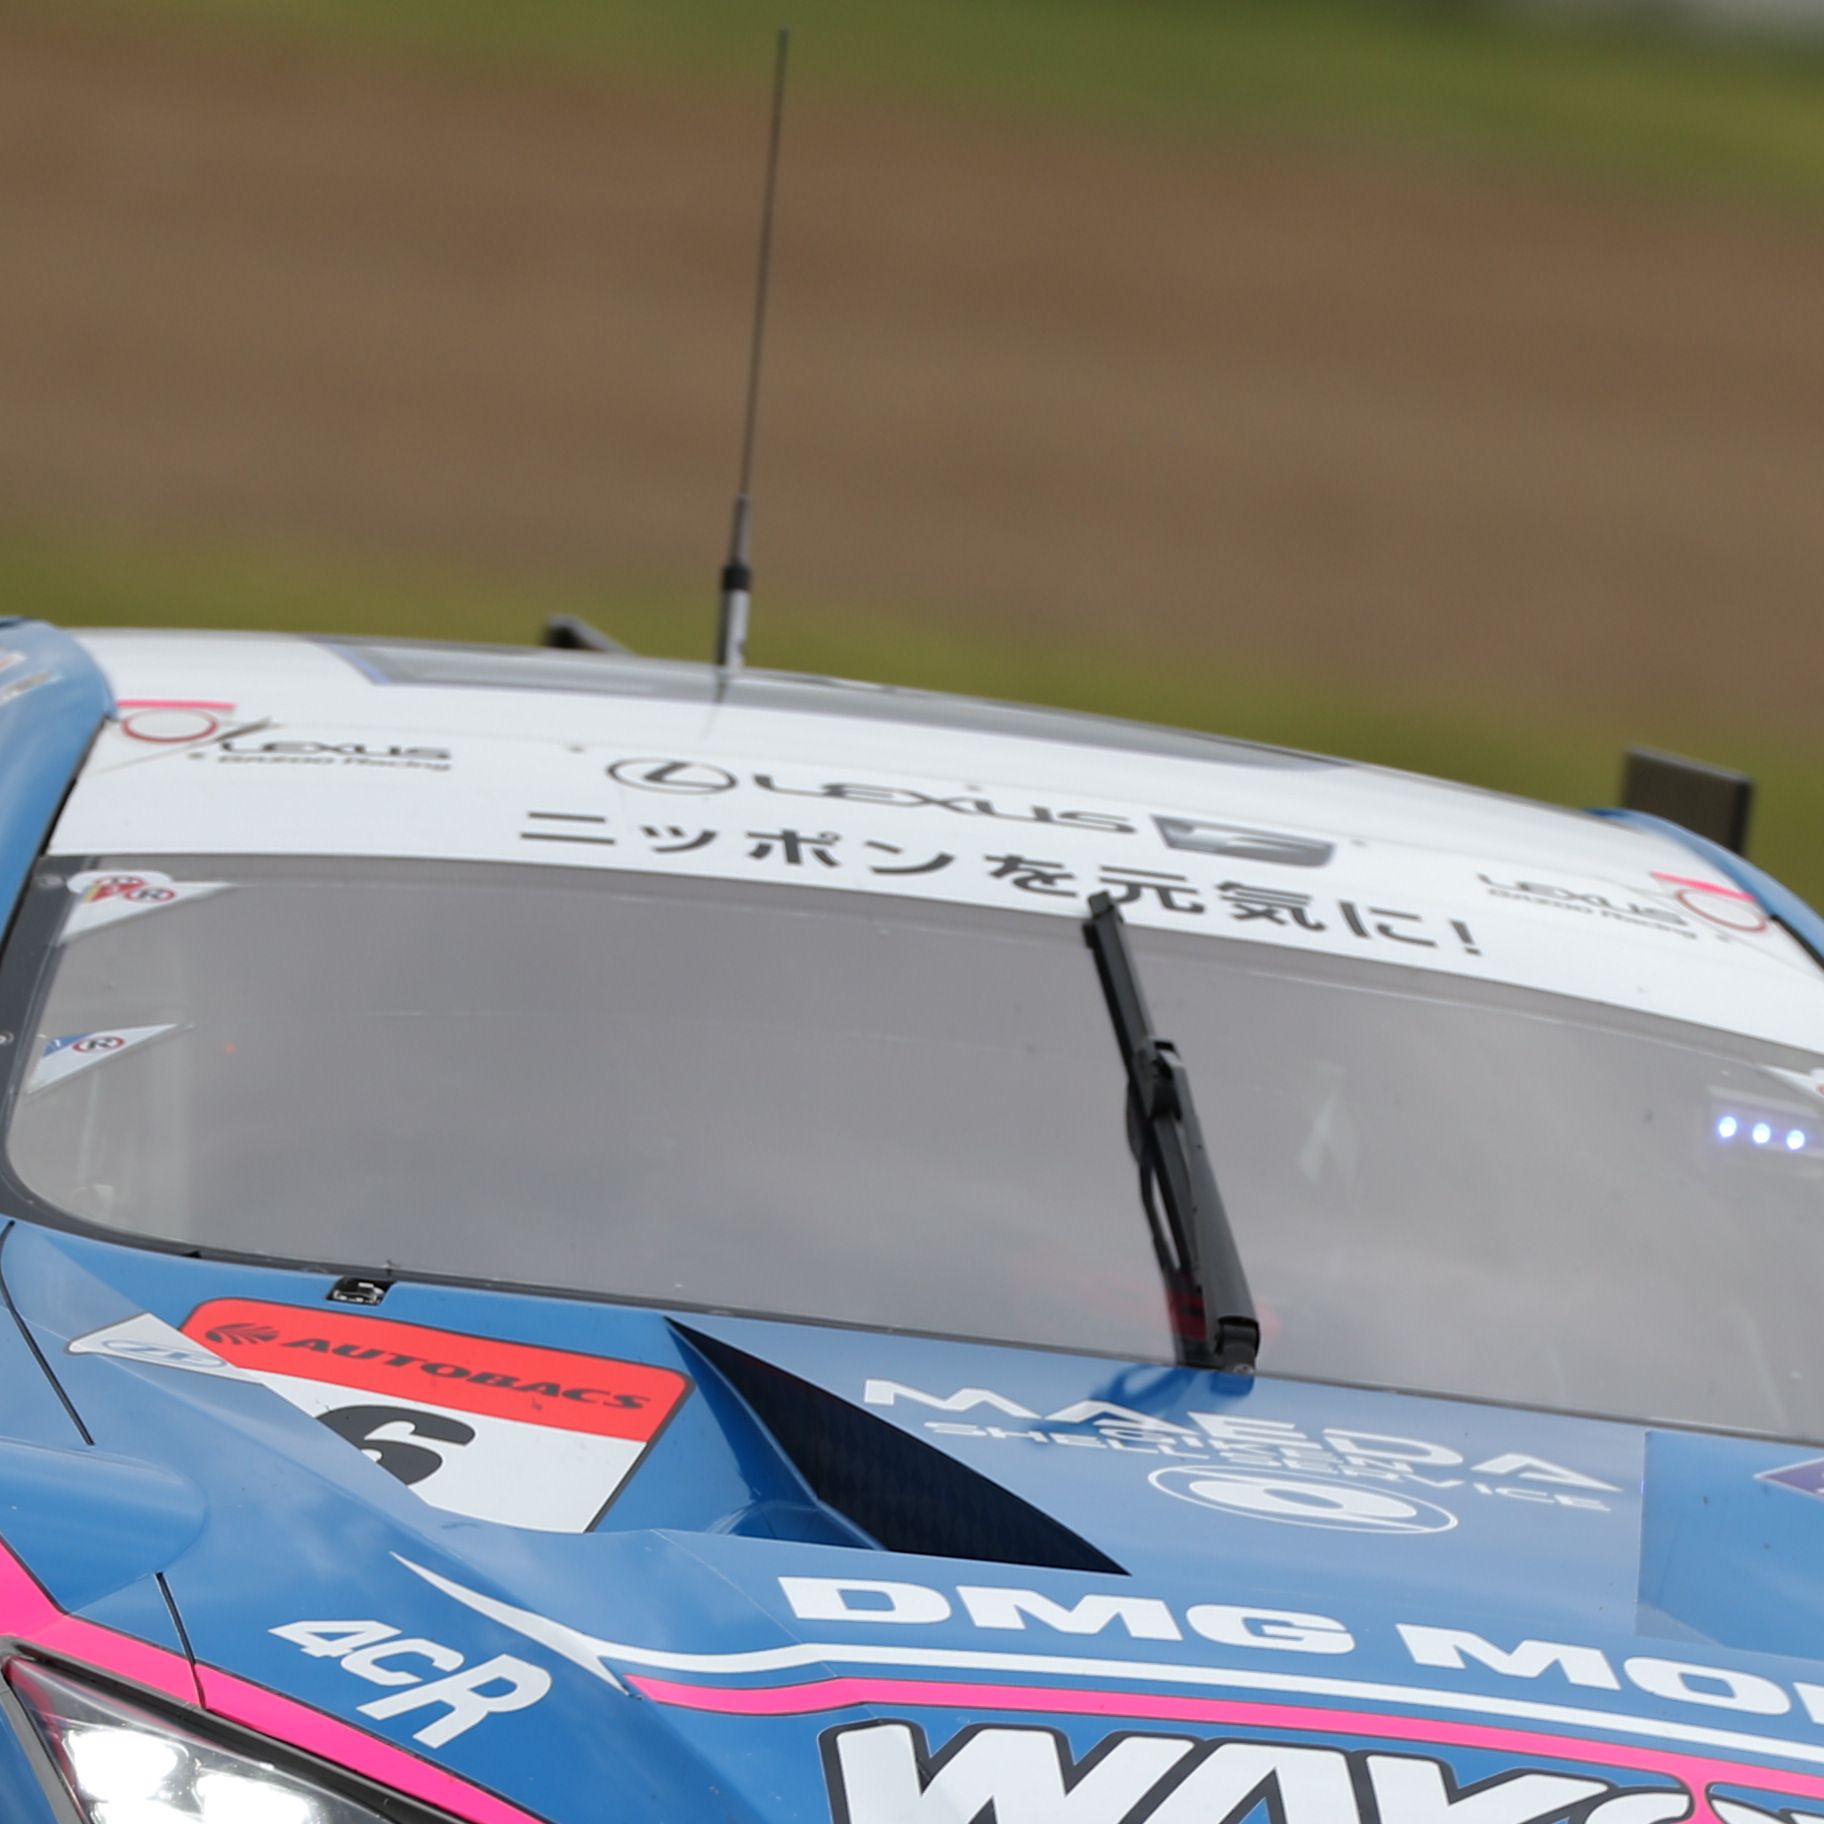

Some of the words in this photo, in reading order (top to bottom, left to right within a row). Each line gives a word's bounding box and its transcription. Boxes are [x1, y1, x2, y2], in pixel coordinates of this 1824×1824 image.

[752, 773, 1138, 835] LEXUS
[284, 1334, 652, 1411] AUTOBACS
[314, 1403, 476, 1487] 6
[863, 1378, 1624, 1493] MAEDA
[922, 1419, 1211, 1460] SHELL
[1225, 1451, 1612, 1512] SERVICE
[776, 1576, 1358, 1655] DMG
[267, 1619, 553, 1750] 4CR
